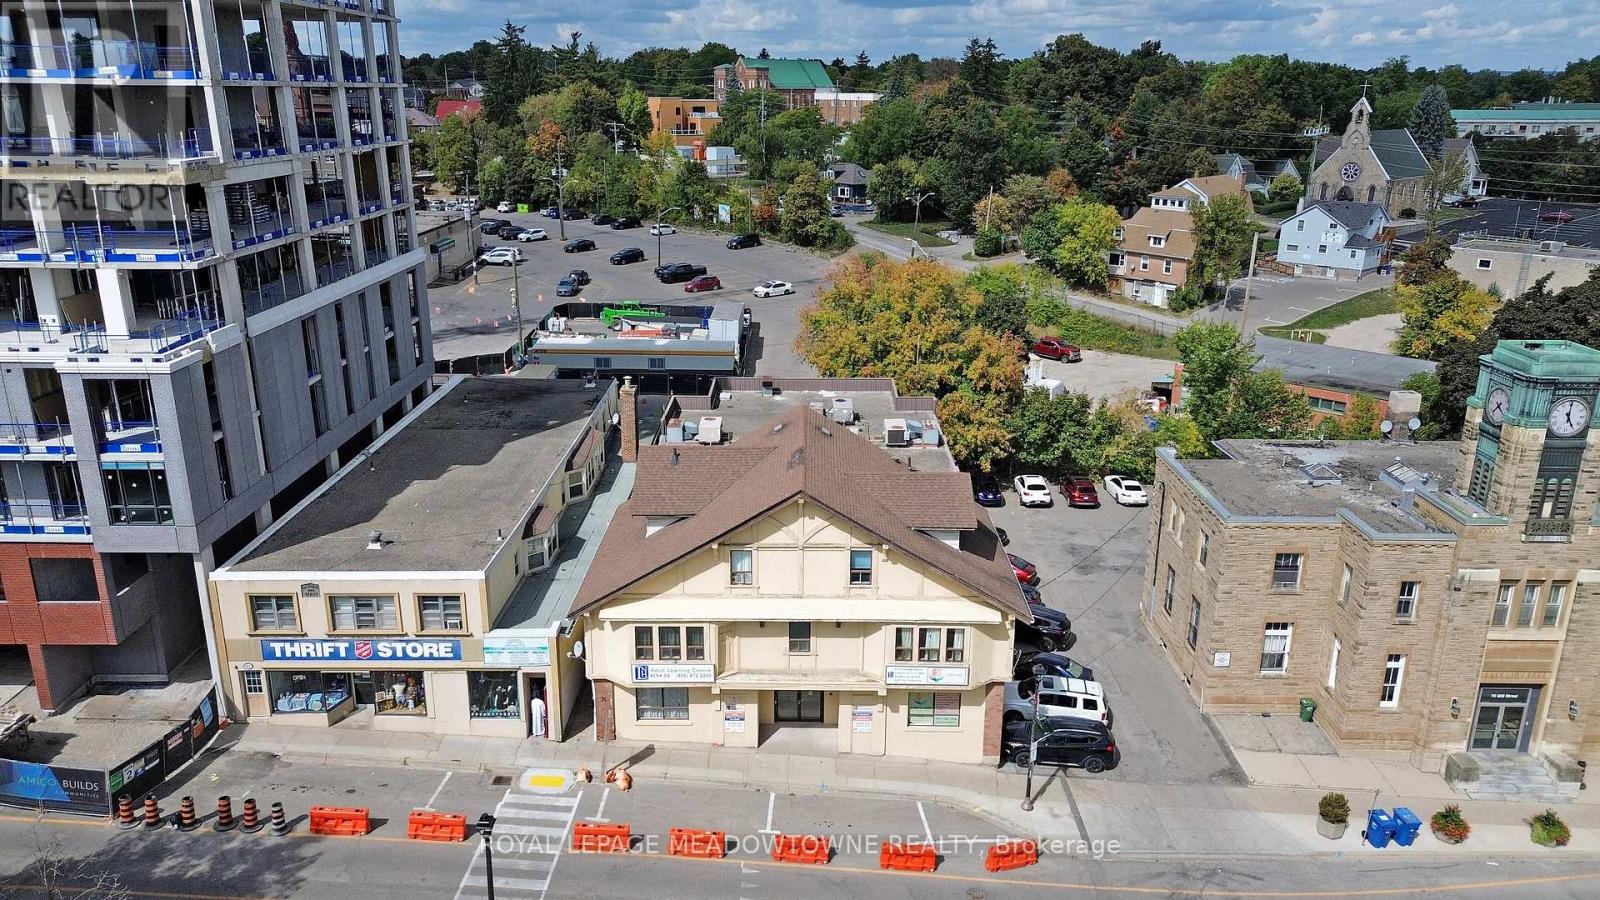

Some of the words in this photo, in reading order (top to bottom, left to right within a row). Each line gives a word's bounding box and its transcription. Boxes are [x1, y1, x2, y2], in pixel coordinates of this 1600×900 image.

[270, 642, 350, 658] THRIFT
[377, 642, 455, 658] STORE
[18, 775, 57, 786] AMICO
[62, 779, 99, 792] BUILDS
